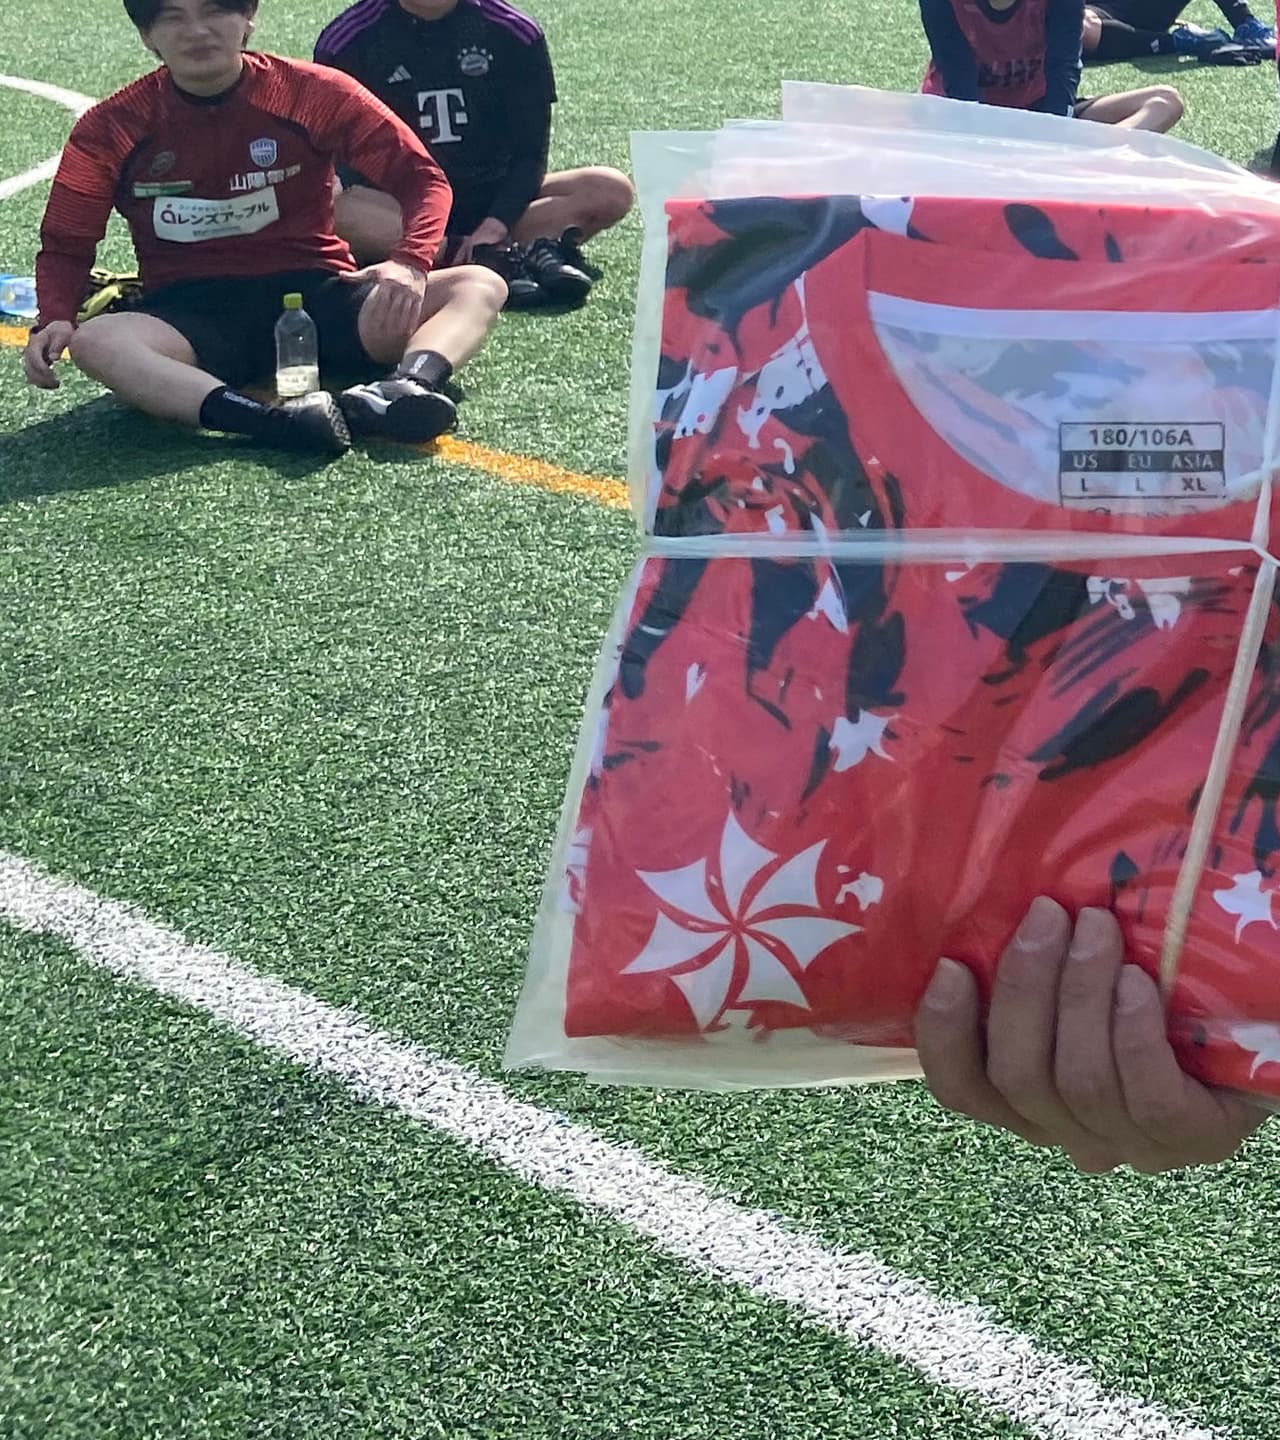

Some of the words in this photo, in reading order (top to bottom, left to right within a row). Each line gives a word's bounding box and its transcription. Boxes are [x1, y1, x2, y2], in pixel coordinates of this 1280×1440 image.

[1088, 428, 1194, 448] 180/106A
[1072, 453, 1098, 469] US
[1127, 453, 1152, 469] EU
[1171, 453, 1214, 469] ASIA
[1081, 477, 1089, 492] L
[1135, 477, 1145, 492] L
[1182, 477, 1207, 492] XL
